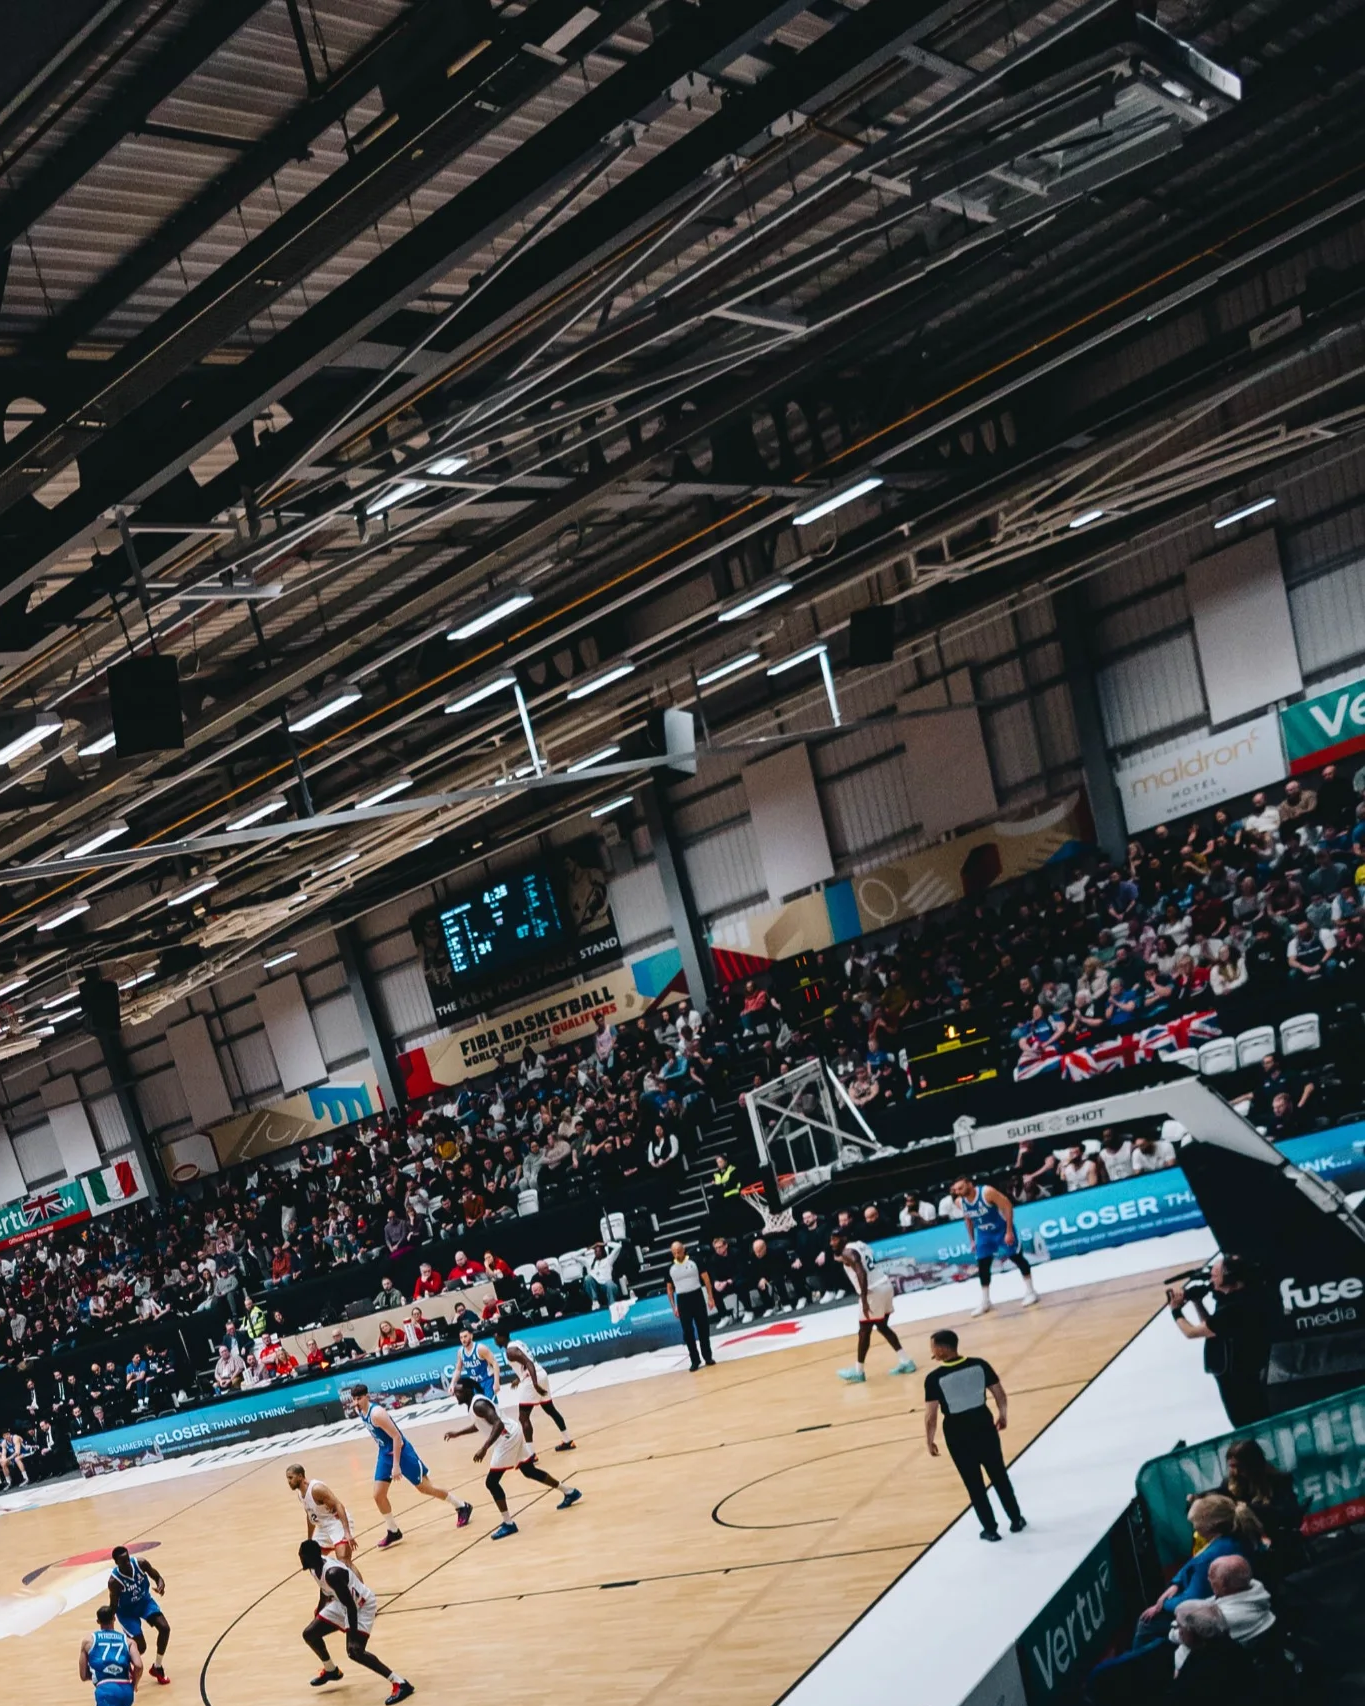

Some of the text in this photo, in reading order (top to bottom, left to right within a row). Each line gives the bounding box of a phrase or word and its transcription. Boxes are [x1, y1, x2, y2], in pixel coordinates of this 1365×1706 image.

[1131, 736, 1255, 797] maldron
[1171, 777, 1218, 799] HOTEL
[436, 1001, 458, 1016] THE
[579, 936, 618, 960] STAND
[460, 986, 615, 1056] FIBA BASKETBALL
[1007, 1107, 1106, 1139] SURE SHOT
[1038, 1196, 1159, 1240] CLOSER
[1280, 1277, 1364, 1315] fuse
[1296, 1306, 1357, 1331] media
[555, 1336, 581, 1350] YOU
[380, 1369, 441, 1392] SUMMER IS
[107, 1439, 144, 1456] SUMMER
[144, 1438, 153, 1447] IS
[155, 1422, 211, 1446] CLOSER
[211, 1417, 237, 1431] THAN
[238, 1412, 258, 1425] YOU
[98, 1642, 124, 1662] 77
[1032, 1580, 1107, 1691] Vertu
